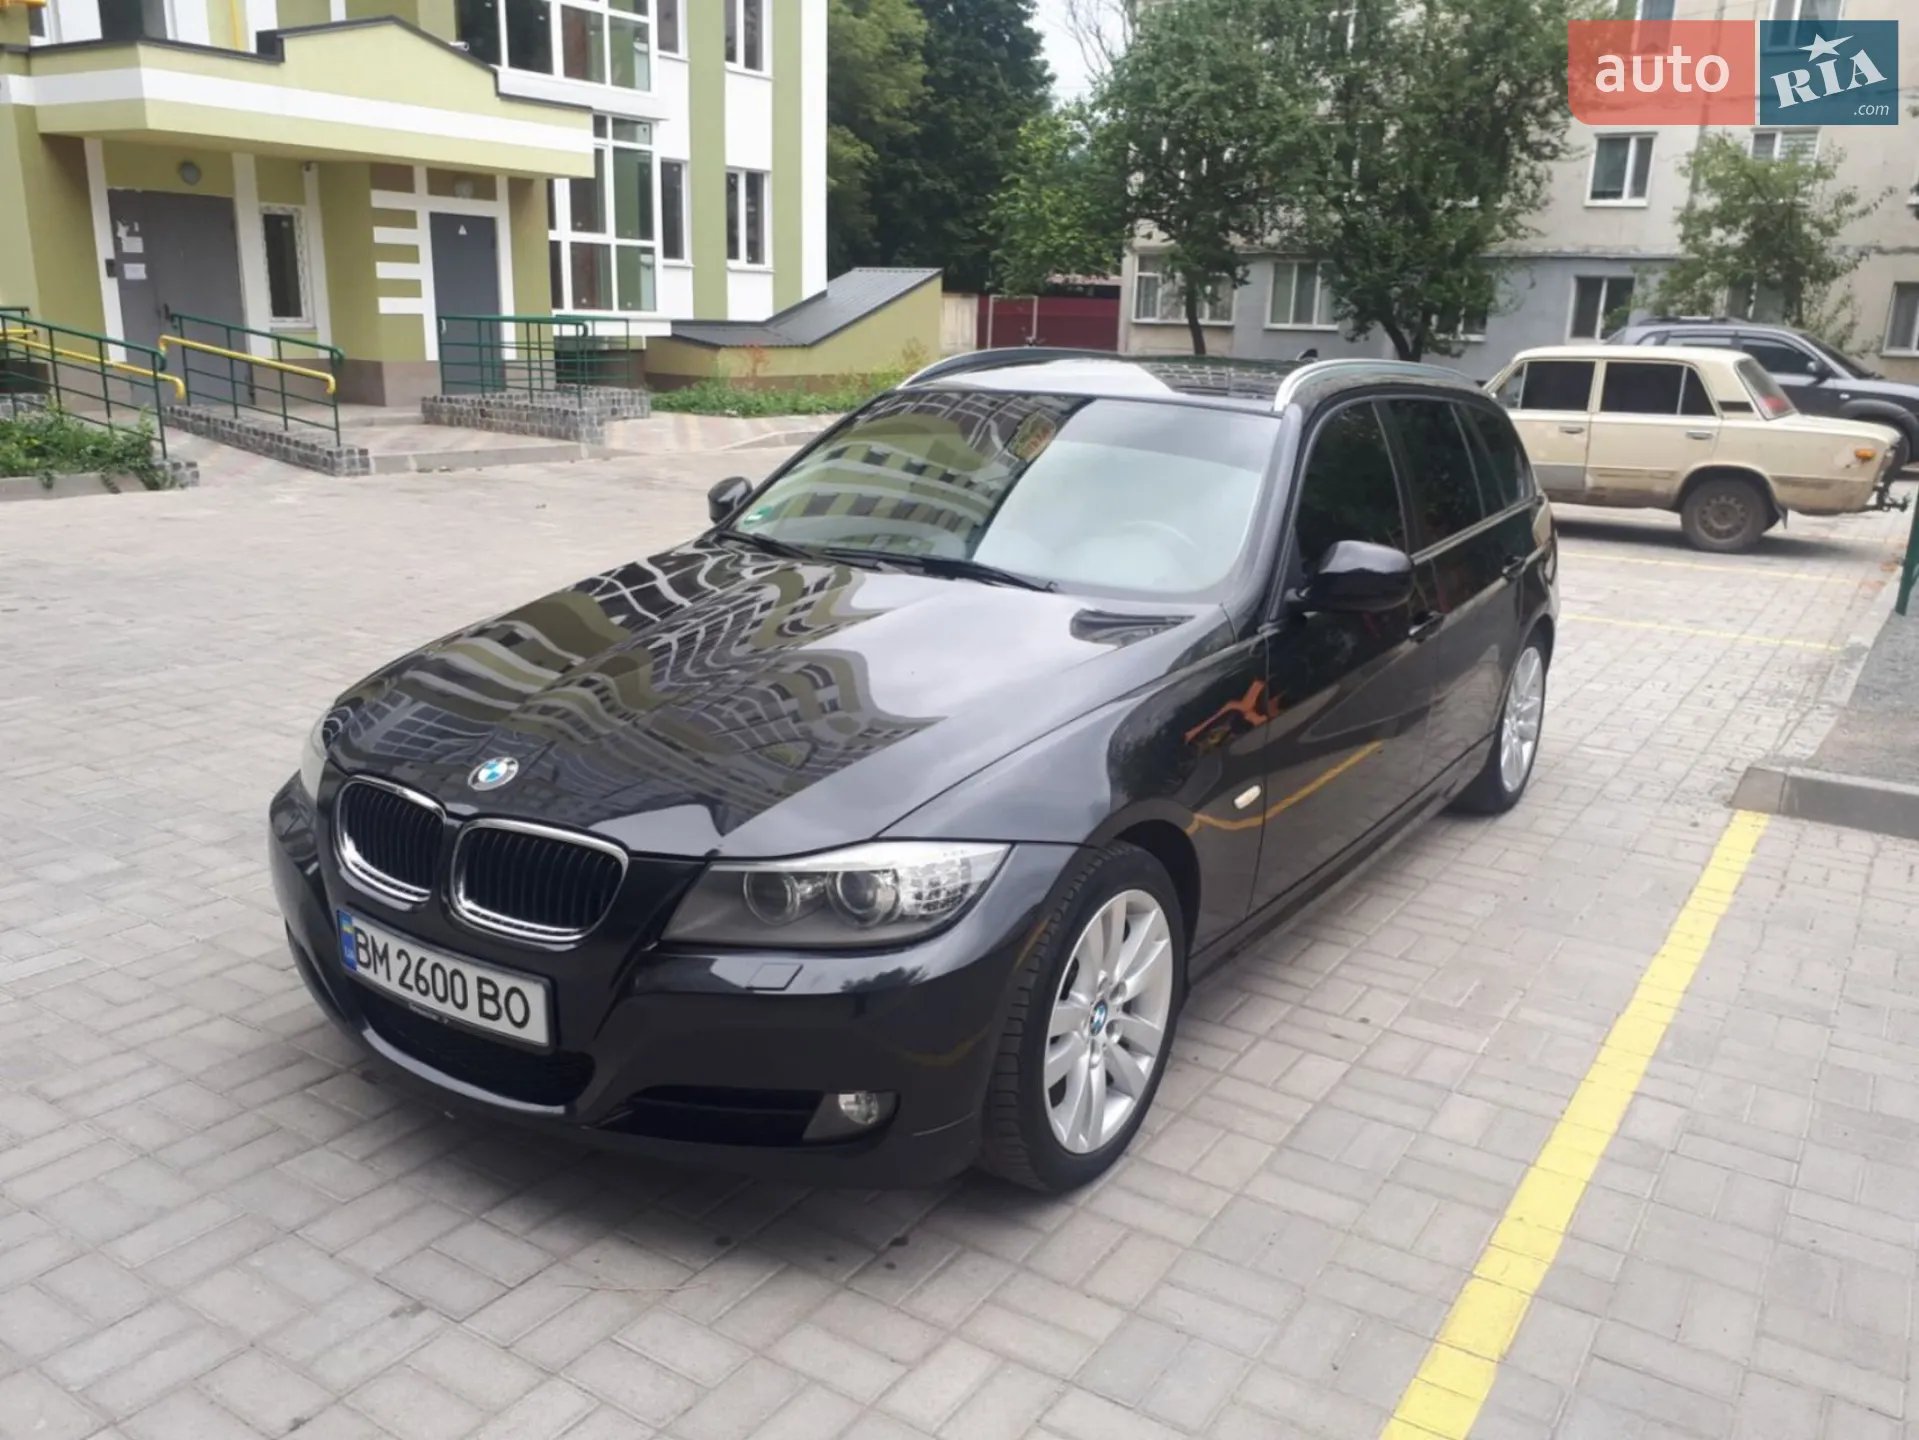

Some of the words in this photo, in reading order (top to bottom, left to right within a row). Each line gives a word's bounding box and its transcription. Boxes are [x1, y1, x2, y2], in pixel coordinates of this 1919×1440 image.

[354, 926, 391, 982] BM
[396, 949, 468, 1011] 2600
[476, 976, 530, 1029] BO
